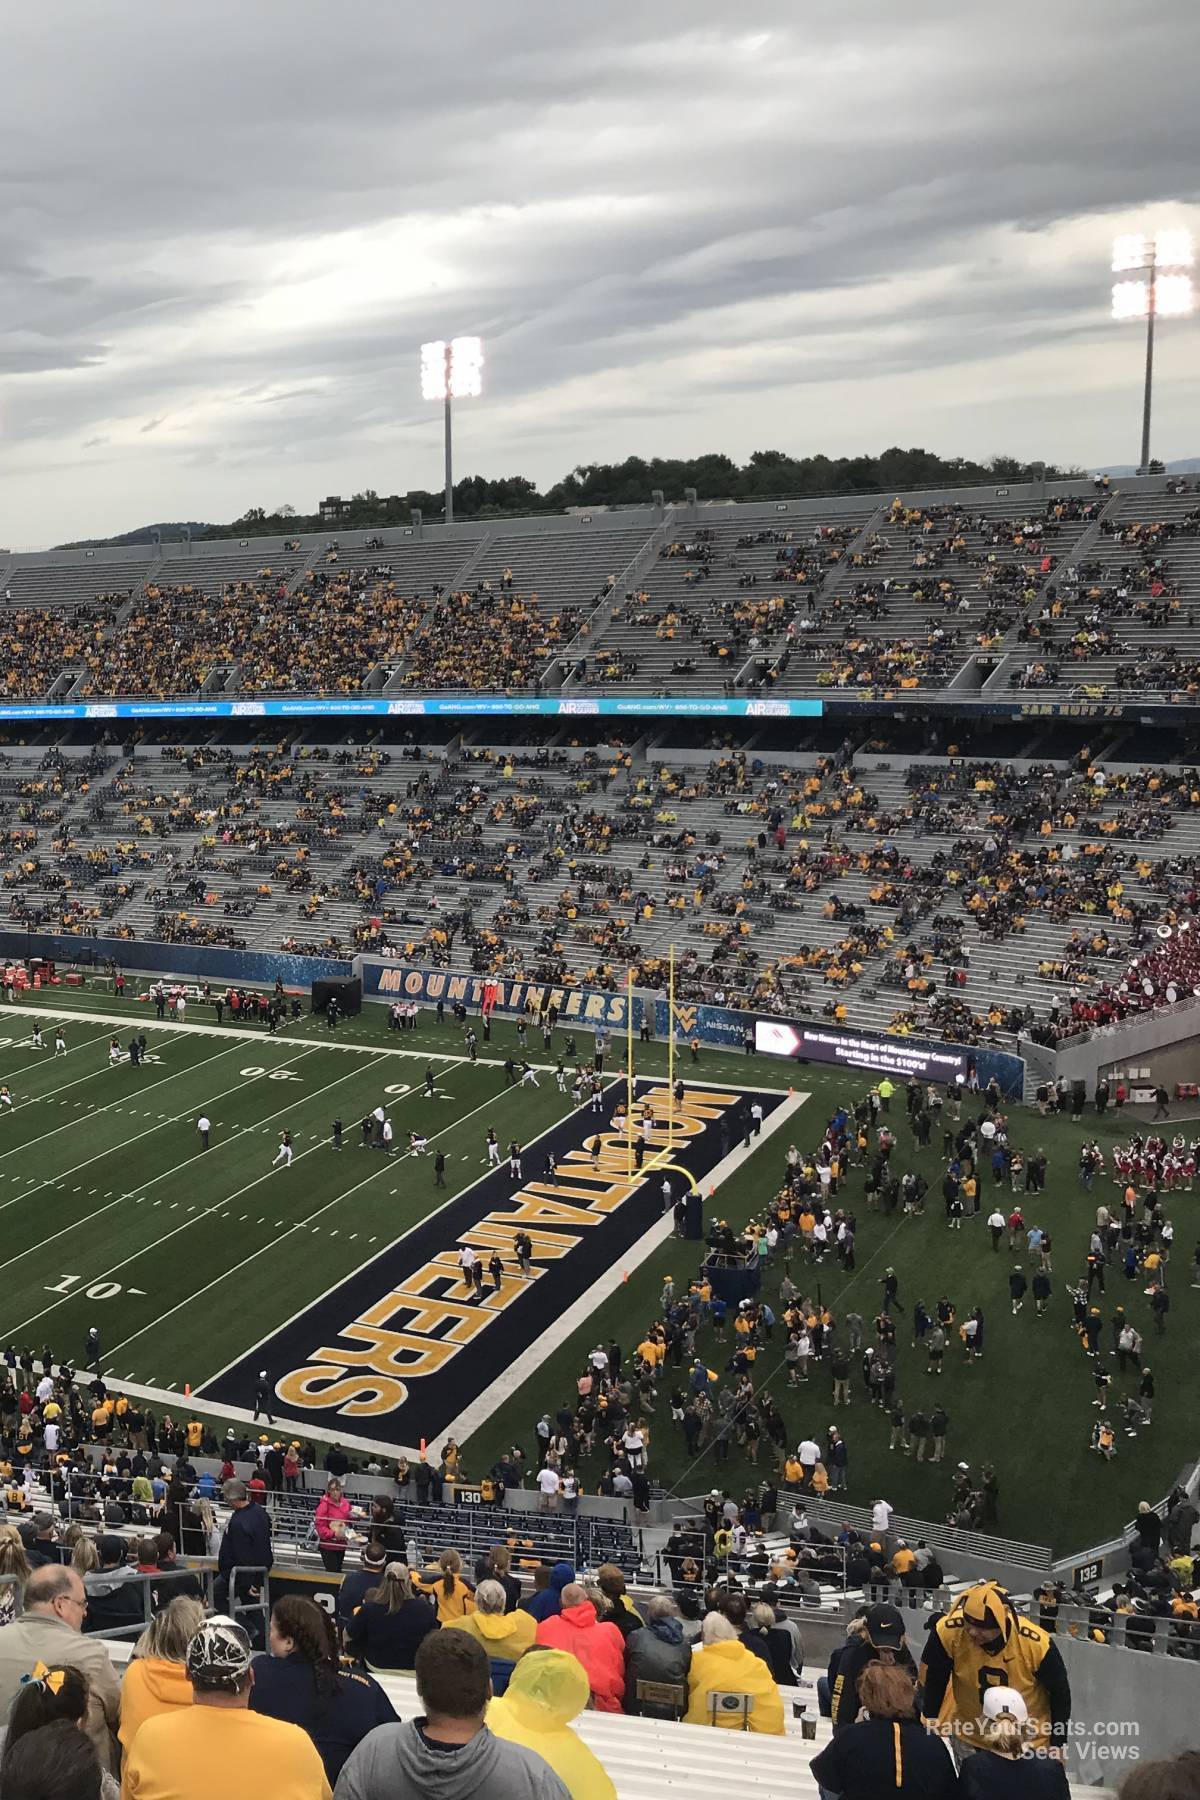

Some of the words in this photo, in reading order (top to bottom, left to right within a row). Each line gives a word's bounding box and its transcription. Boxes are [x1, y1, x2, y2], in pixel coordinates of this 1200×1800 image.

[558, 702, 576, 714] AIR
[745, 703, 766, 716] AIR
[1021, 704, 1053, 716] SAM
[1059, 704, 1098, 716] HUFF
[377, 968, 627, 1022] MOUNTAINEERS
[706, 1020, 744, 1034] NISSAN
[835, 1047, 870, 1062] Starting
[879, 1053, 895, 1065] the
[848, 1037, 860, 1048] the
[860, 1039, 880, 1051] Heart
[931, 1051, 962, 1066] Country!
[274, 1086, 743, 1418] MOUNTAINEERS
[43, 1273, 123, 1300] 10
[460, 1491, 481, 1504] 130
[1080, 1564, 1098, 1583] 132
[944, 1617, 965, 1629] 8
[1020, 1625, 1041, 1642] 8
